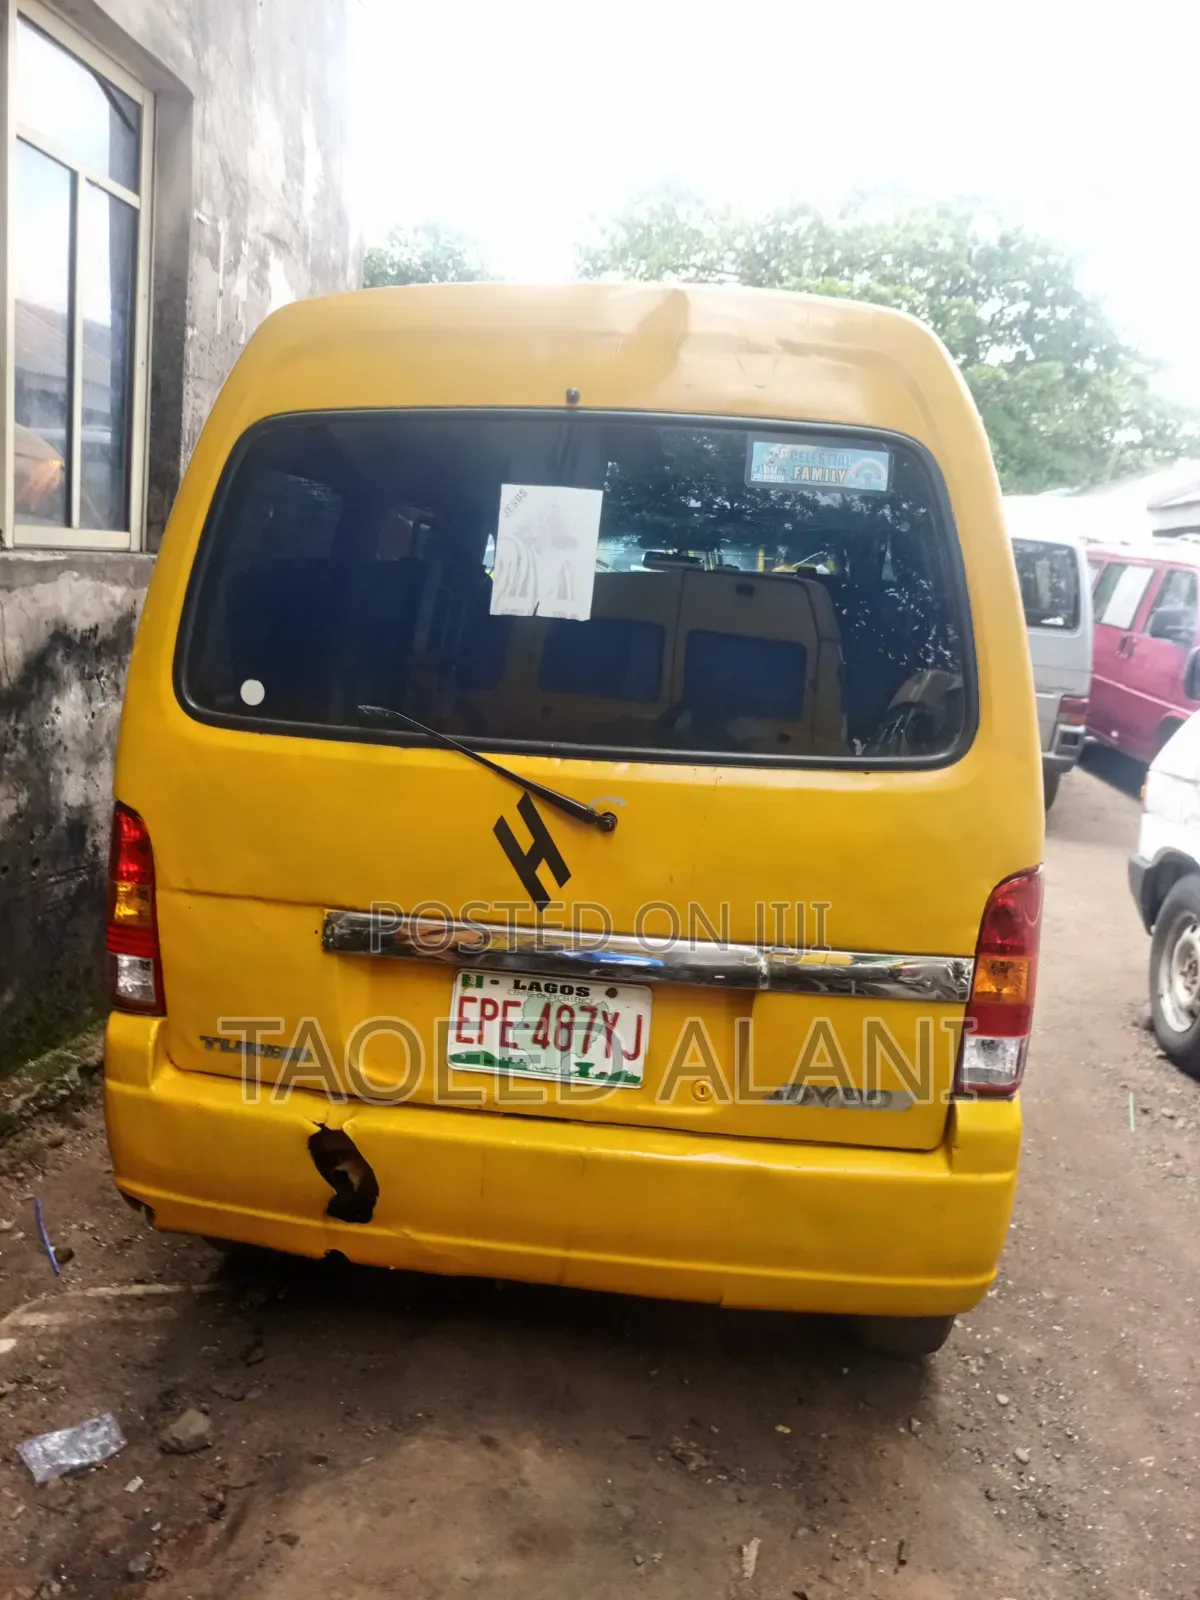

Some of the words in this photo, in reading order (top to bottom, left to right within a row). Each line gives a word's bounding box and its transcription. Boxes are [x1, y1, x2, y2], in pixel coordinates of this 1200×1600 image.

[789, 449, 852, 468] CELESTIAL
[792, 465, 847, 483] FAMILY
[503, 487, 528, 519] JESUS
[507, 989, 536, 999] CENTRE
[548, 993, 595, 1005] EXCELLENCE
[512, 978, 591, 998] LAGOS
